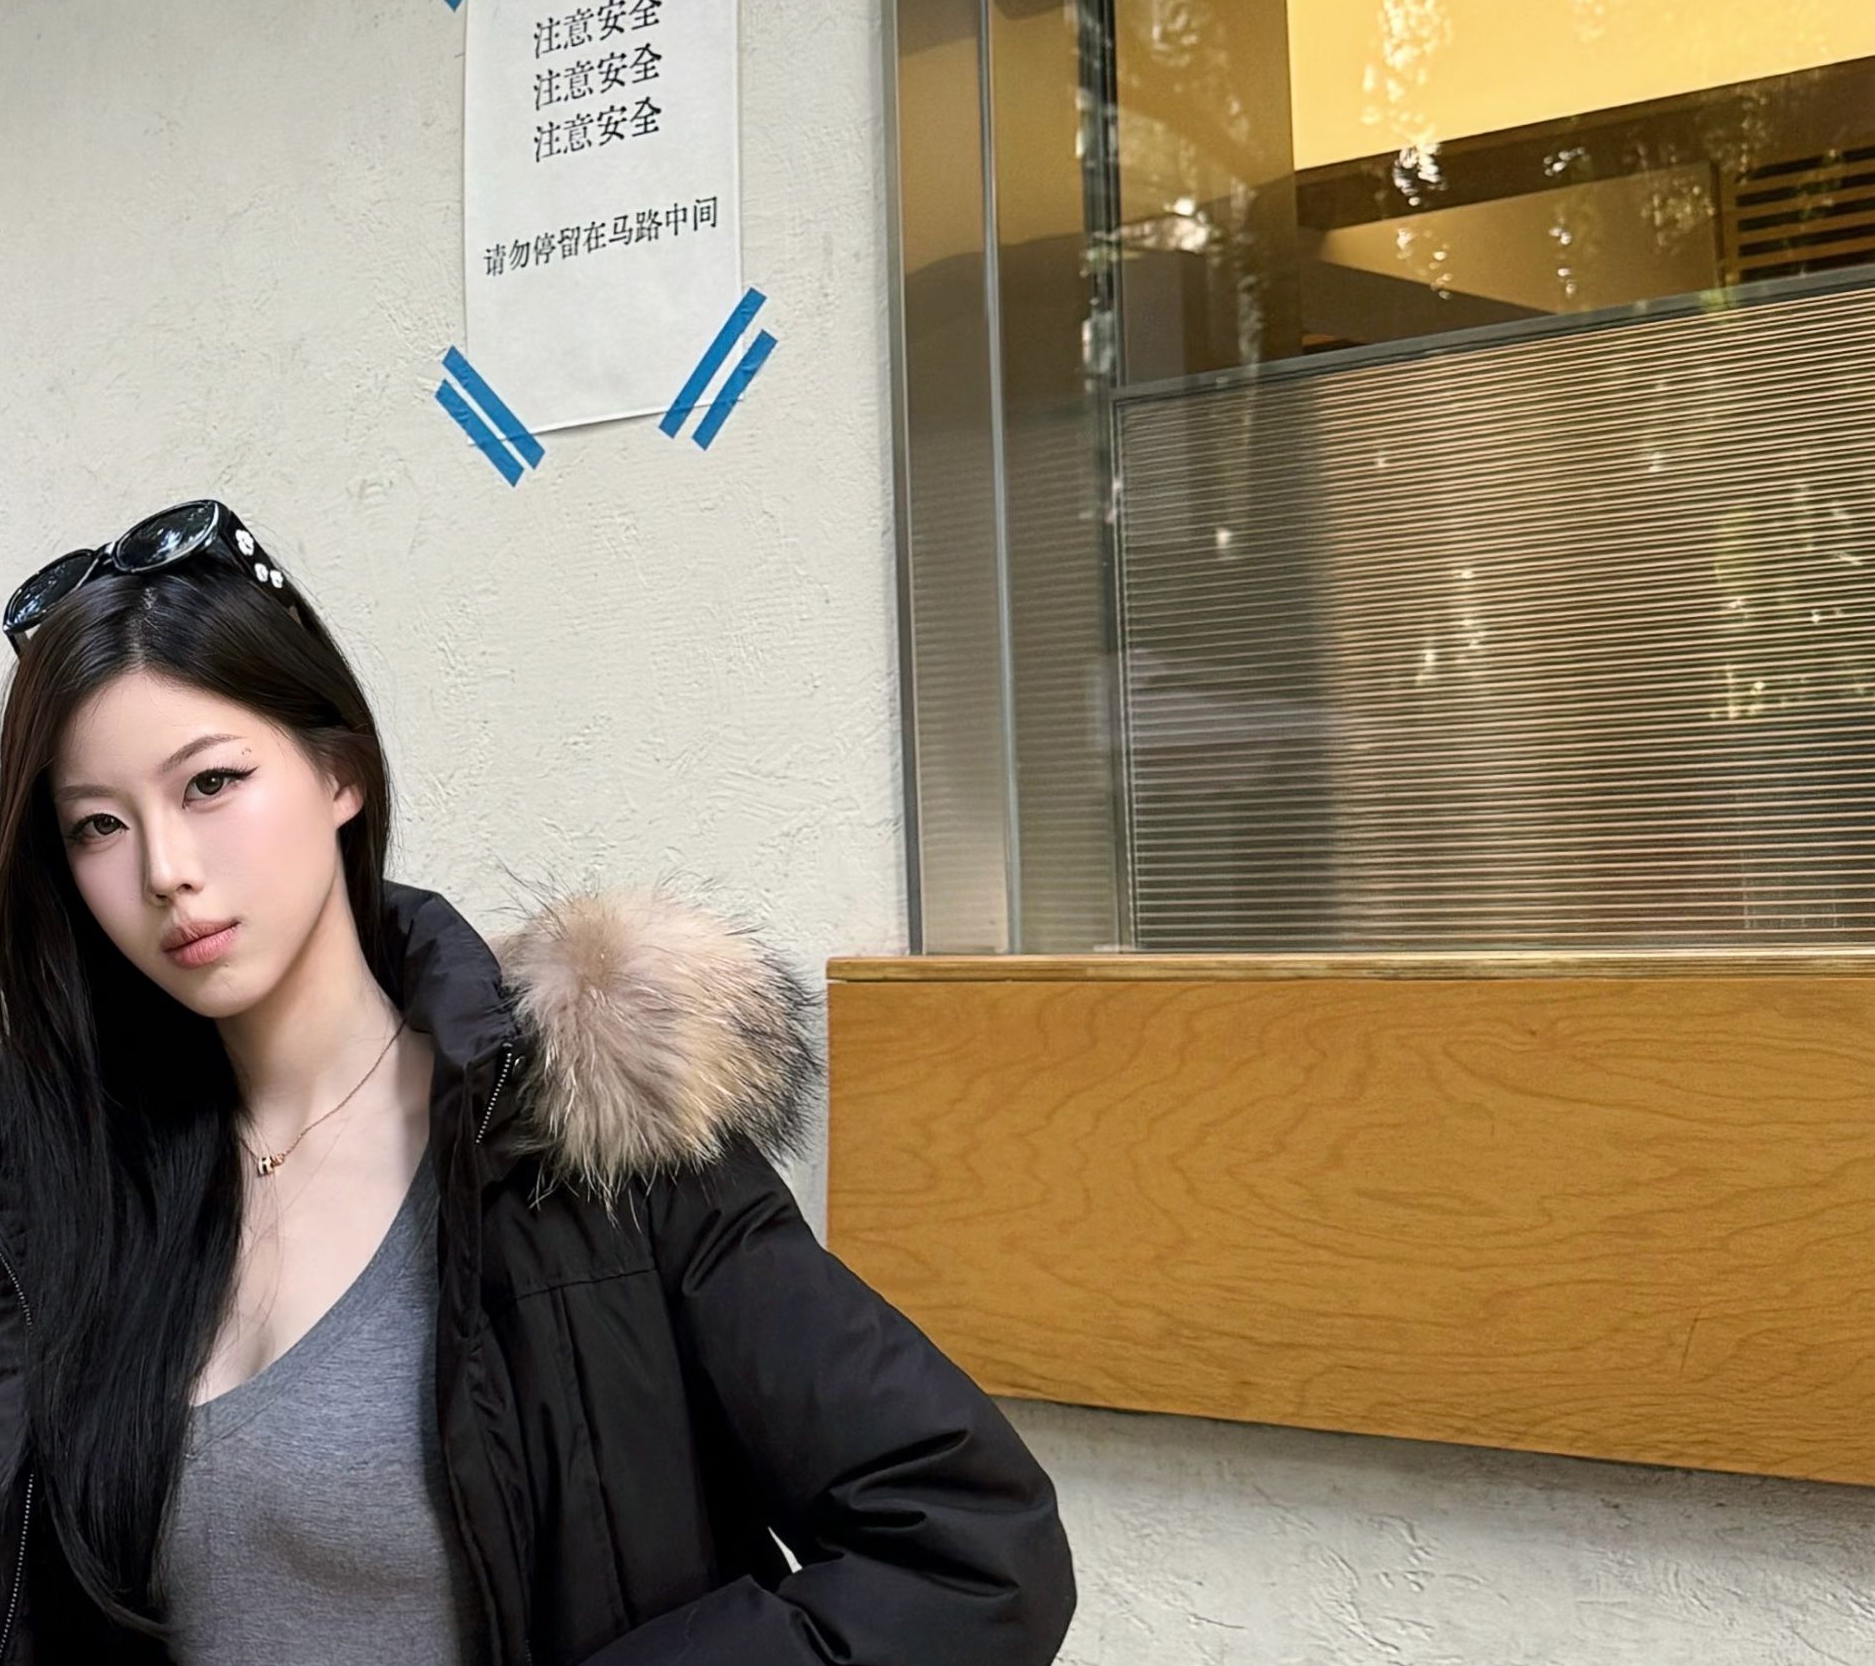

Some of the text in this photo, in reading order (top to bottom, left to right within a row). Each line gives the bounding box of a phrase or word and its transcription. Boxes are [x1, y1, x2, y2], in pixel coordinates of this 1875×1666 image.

[533, 42, 663, 112] 注意安全
[533, 96, 663, 164] 注意安全
[483, 196, 718, 277] 请勿停留在马路中间
